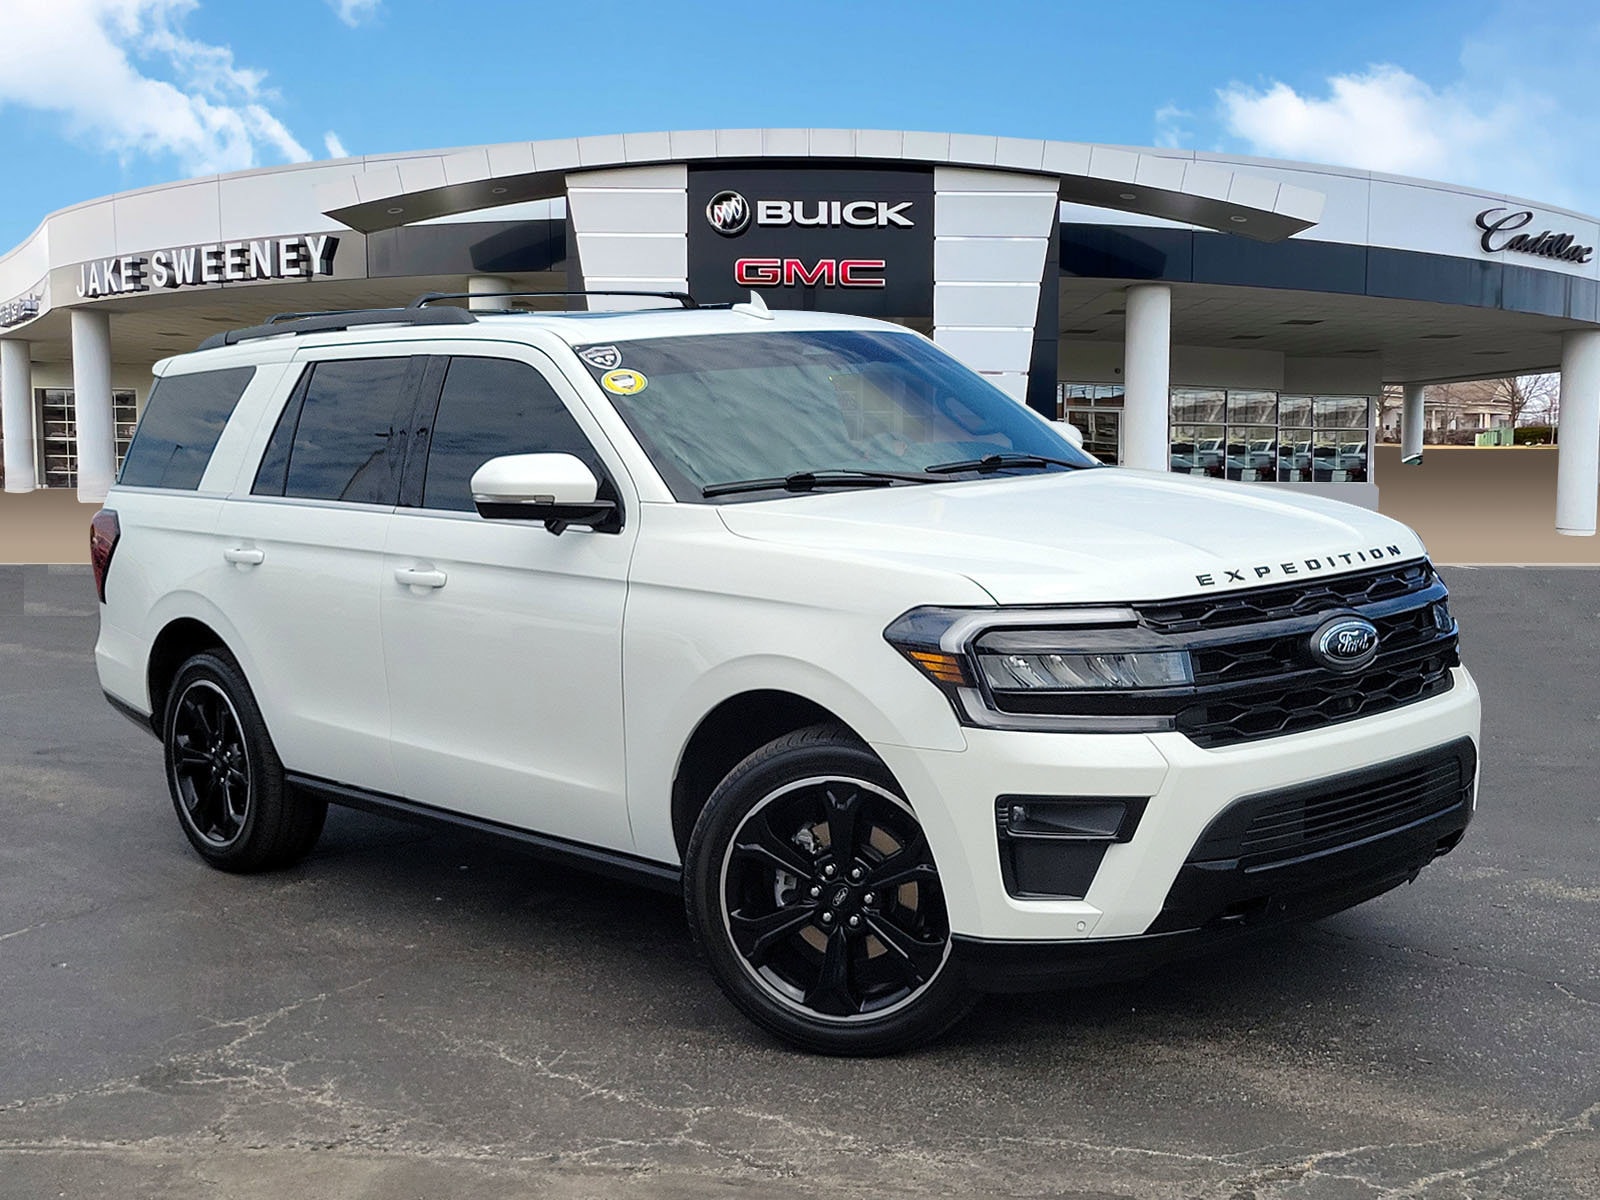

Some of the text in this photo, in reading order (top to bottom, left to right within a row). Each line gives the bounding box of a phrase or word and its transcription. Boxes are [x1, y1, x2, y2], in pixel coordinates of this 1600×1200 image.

[757, 200, 915, 227] BUICK
[1475, 207, 1593, 263] Cadillac
[75, 234, 340, 299] JAKE SWEENEY
[735, 257, 886, 287] GMC
[1196, 544, 1402, 587] EXPEDITION
[1337, 630, 1370, 655] Ford
